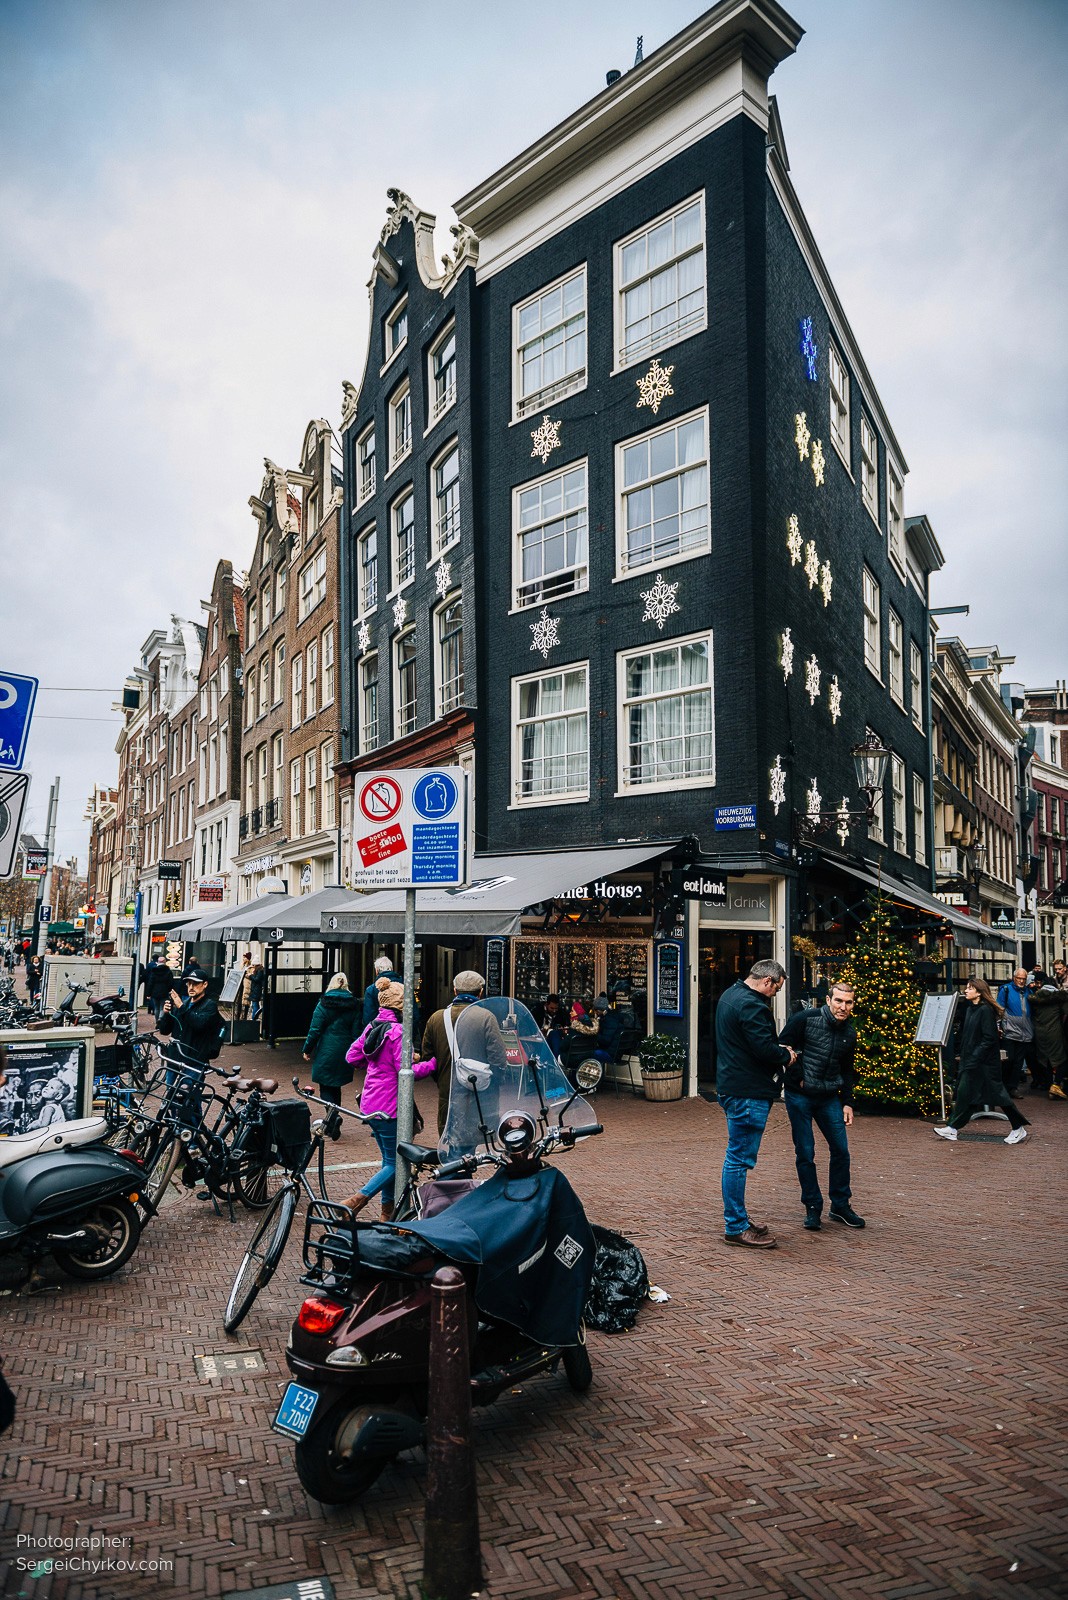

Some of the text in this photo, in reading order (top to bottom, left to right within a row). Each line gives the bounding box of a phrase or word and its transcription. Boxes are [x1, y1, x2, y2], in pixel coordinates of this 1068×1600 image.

[718, 807, 752, 816] NIEUWEZIJDS
[715, 815, 755, 824] VOORBURGWAL
[369, 830, 387, 842] boete
[377, 849, 391, 859] fine
[354, 869, 374, 877] grofvuil
[594, 882, 643, 899] House
[932, 892, 968, 906] OTEL
[43, 906, 49, 914] P
[293, 1390, 315, 1412] F22
[286, 1408, 309, 1430] 7DH
